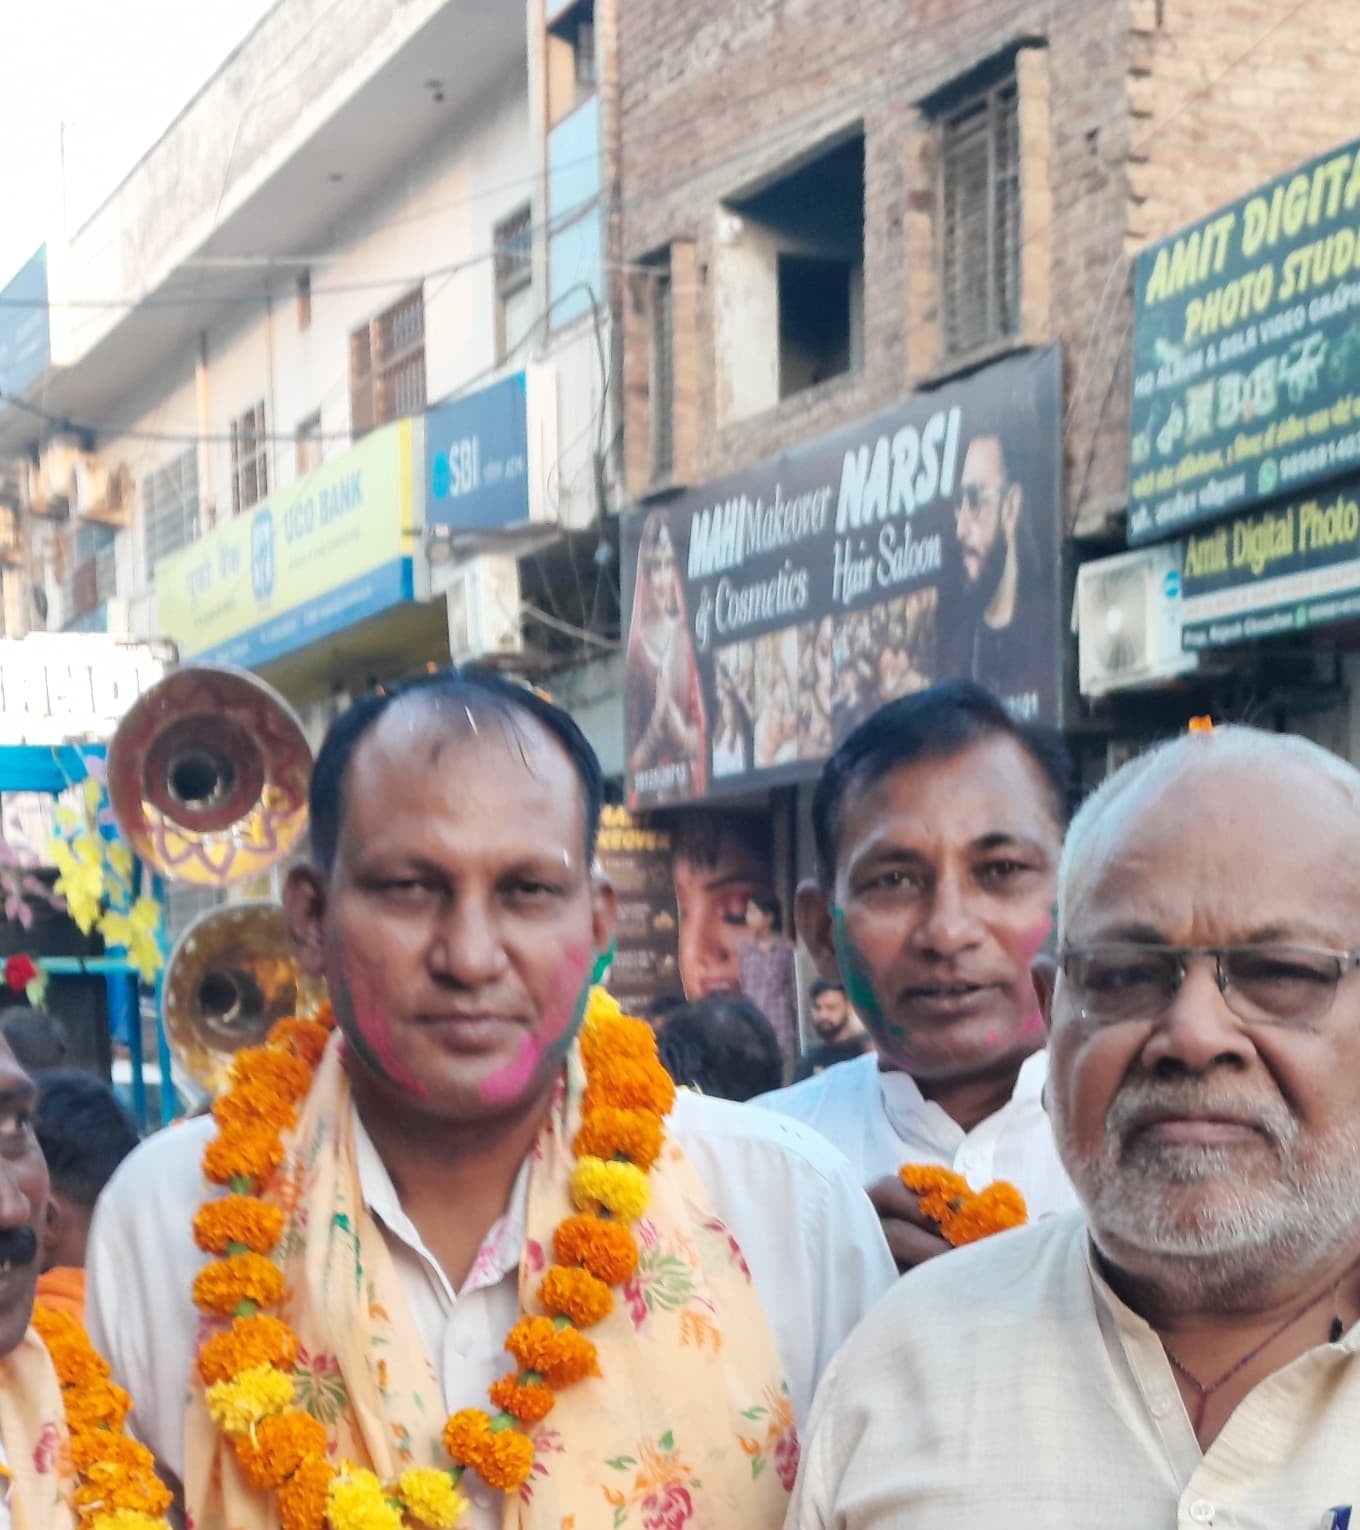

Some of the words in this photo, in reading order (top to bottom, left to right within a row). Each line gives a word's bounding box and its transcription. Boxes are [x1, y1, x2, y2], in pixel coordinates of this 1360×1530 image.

[1145, 213, 1235, 305] AMIT
[1183, 263, 1274, 344] PHOTO
[1260, 304, 1306, 344] VIDEO
[283, 508, 314, 544] UCO
[319, 468, 364, 528] BANK
[448, 436, 480, 497] SBI
[836, 405, 961, 534] NARSI
[687, 494, 746, 579] MAHI
[744, 482, 832, 556] Makeover
[832, 537, 875, 605] Hair
[876, 521, 942, 588] Saloon
[1184, 526, 1228, 578] Amit
[1233, 507, 1294, 575] Digital
[1298, 495, 1359, 550] Photo
[715, 559, 808, 624] Cosmetics
